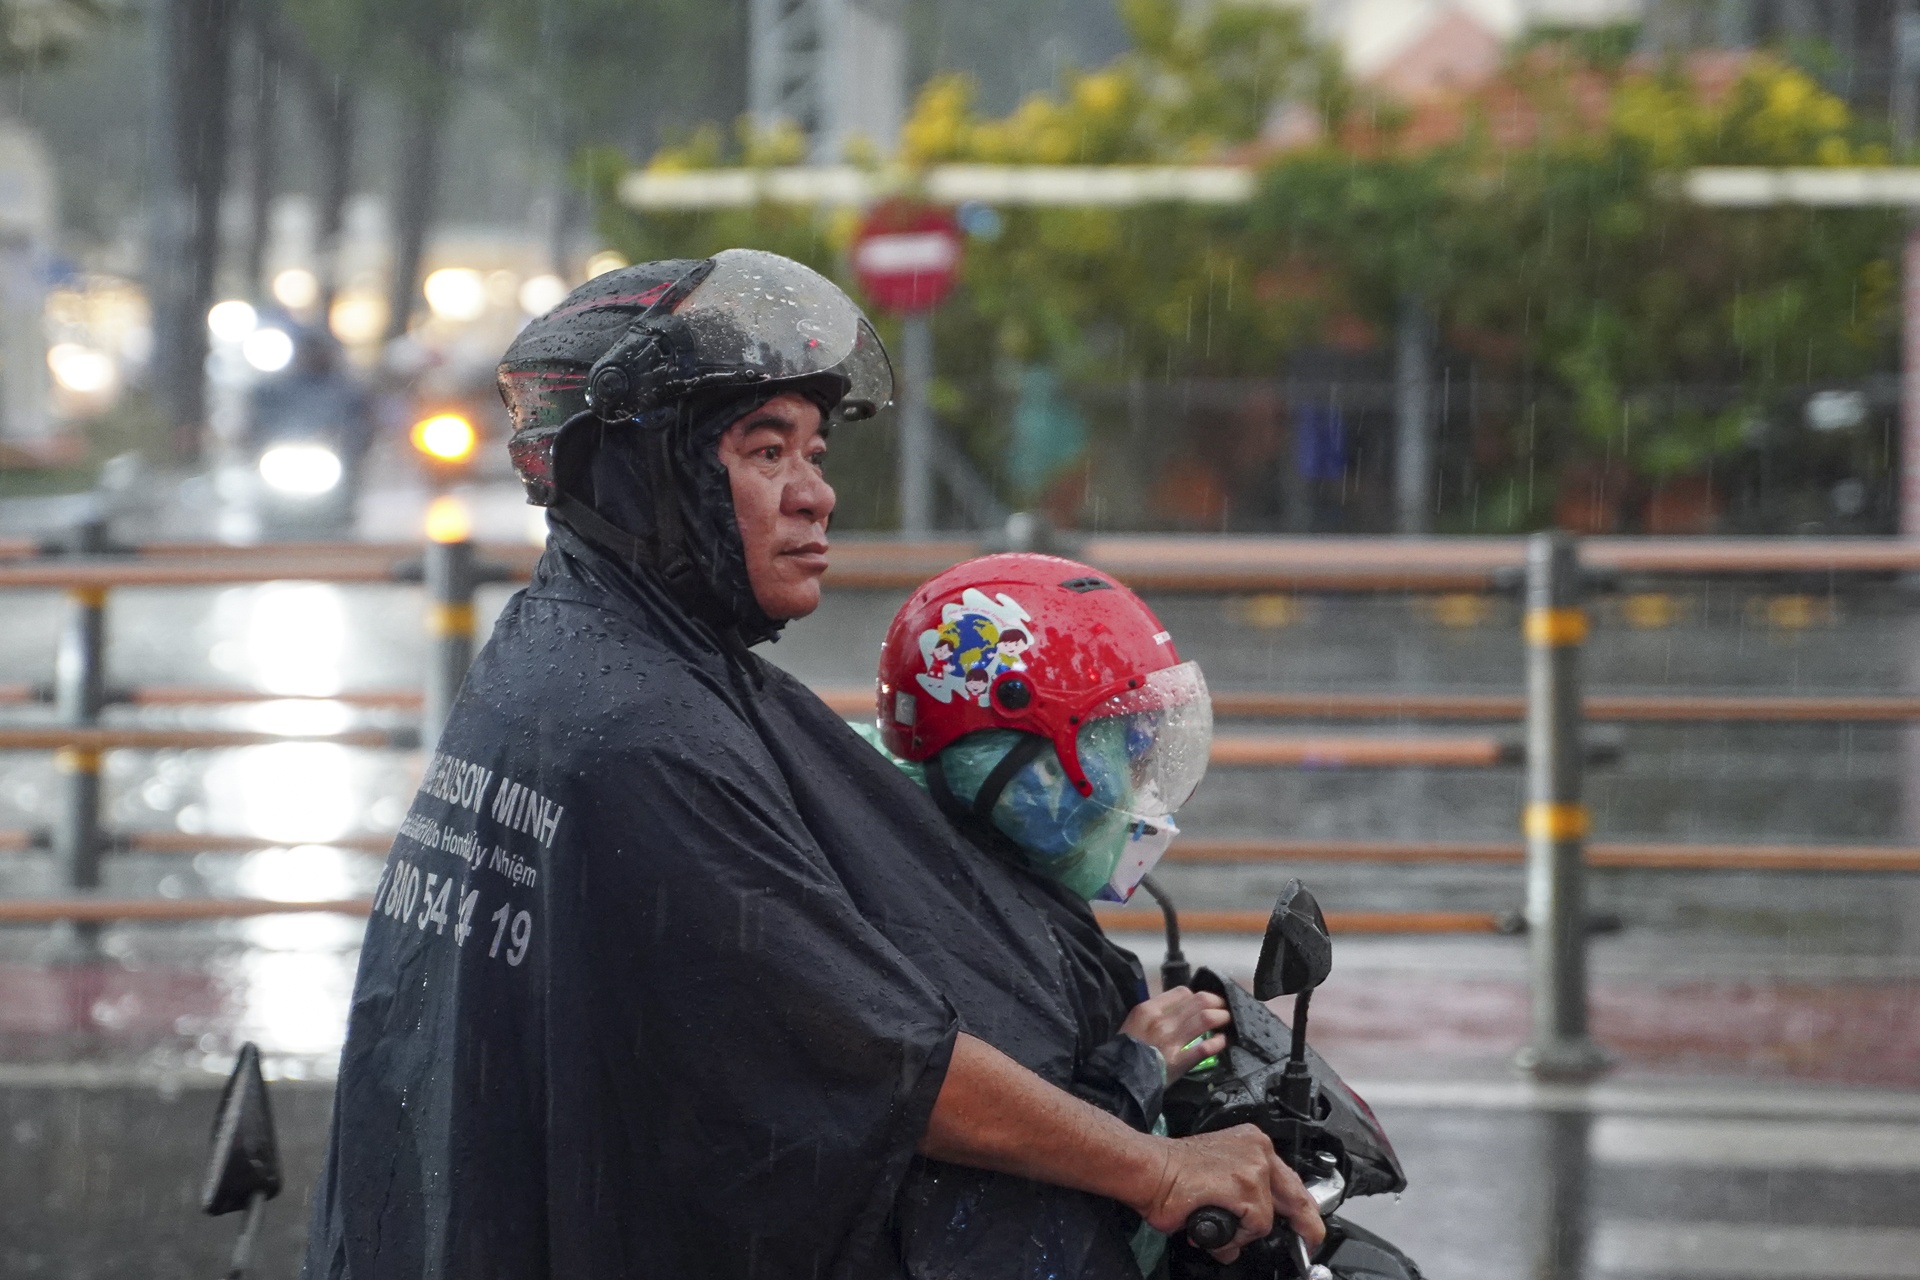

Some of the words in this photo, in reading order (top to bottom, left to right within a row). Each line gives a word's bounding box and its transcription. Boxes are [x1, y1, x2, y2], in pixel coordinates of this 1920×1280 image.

[492, 777, 564, 848] MINH
[489, 845, 537, 887] Nhiệm
[418, 872, 453, 935] 54
[489, 903, 532, 967] 19
